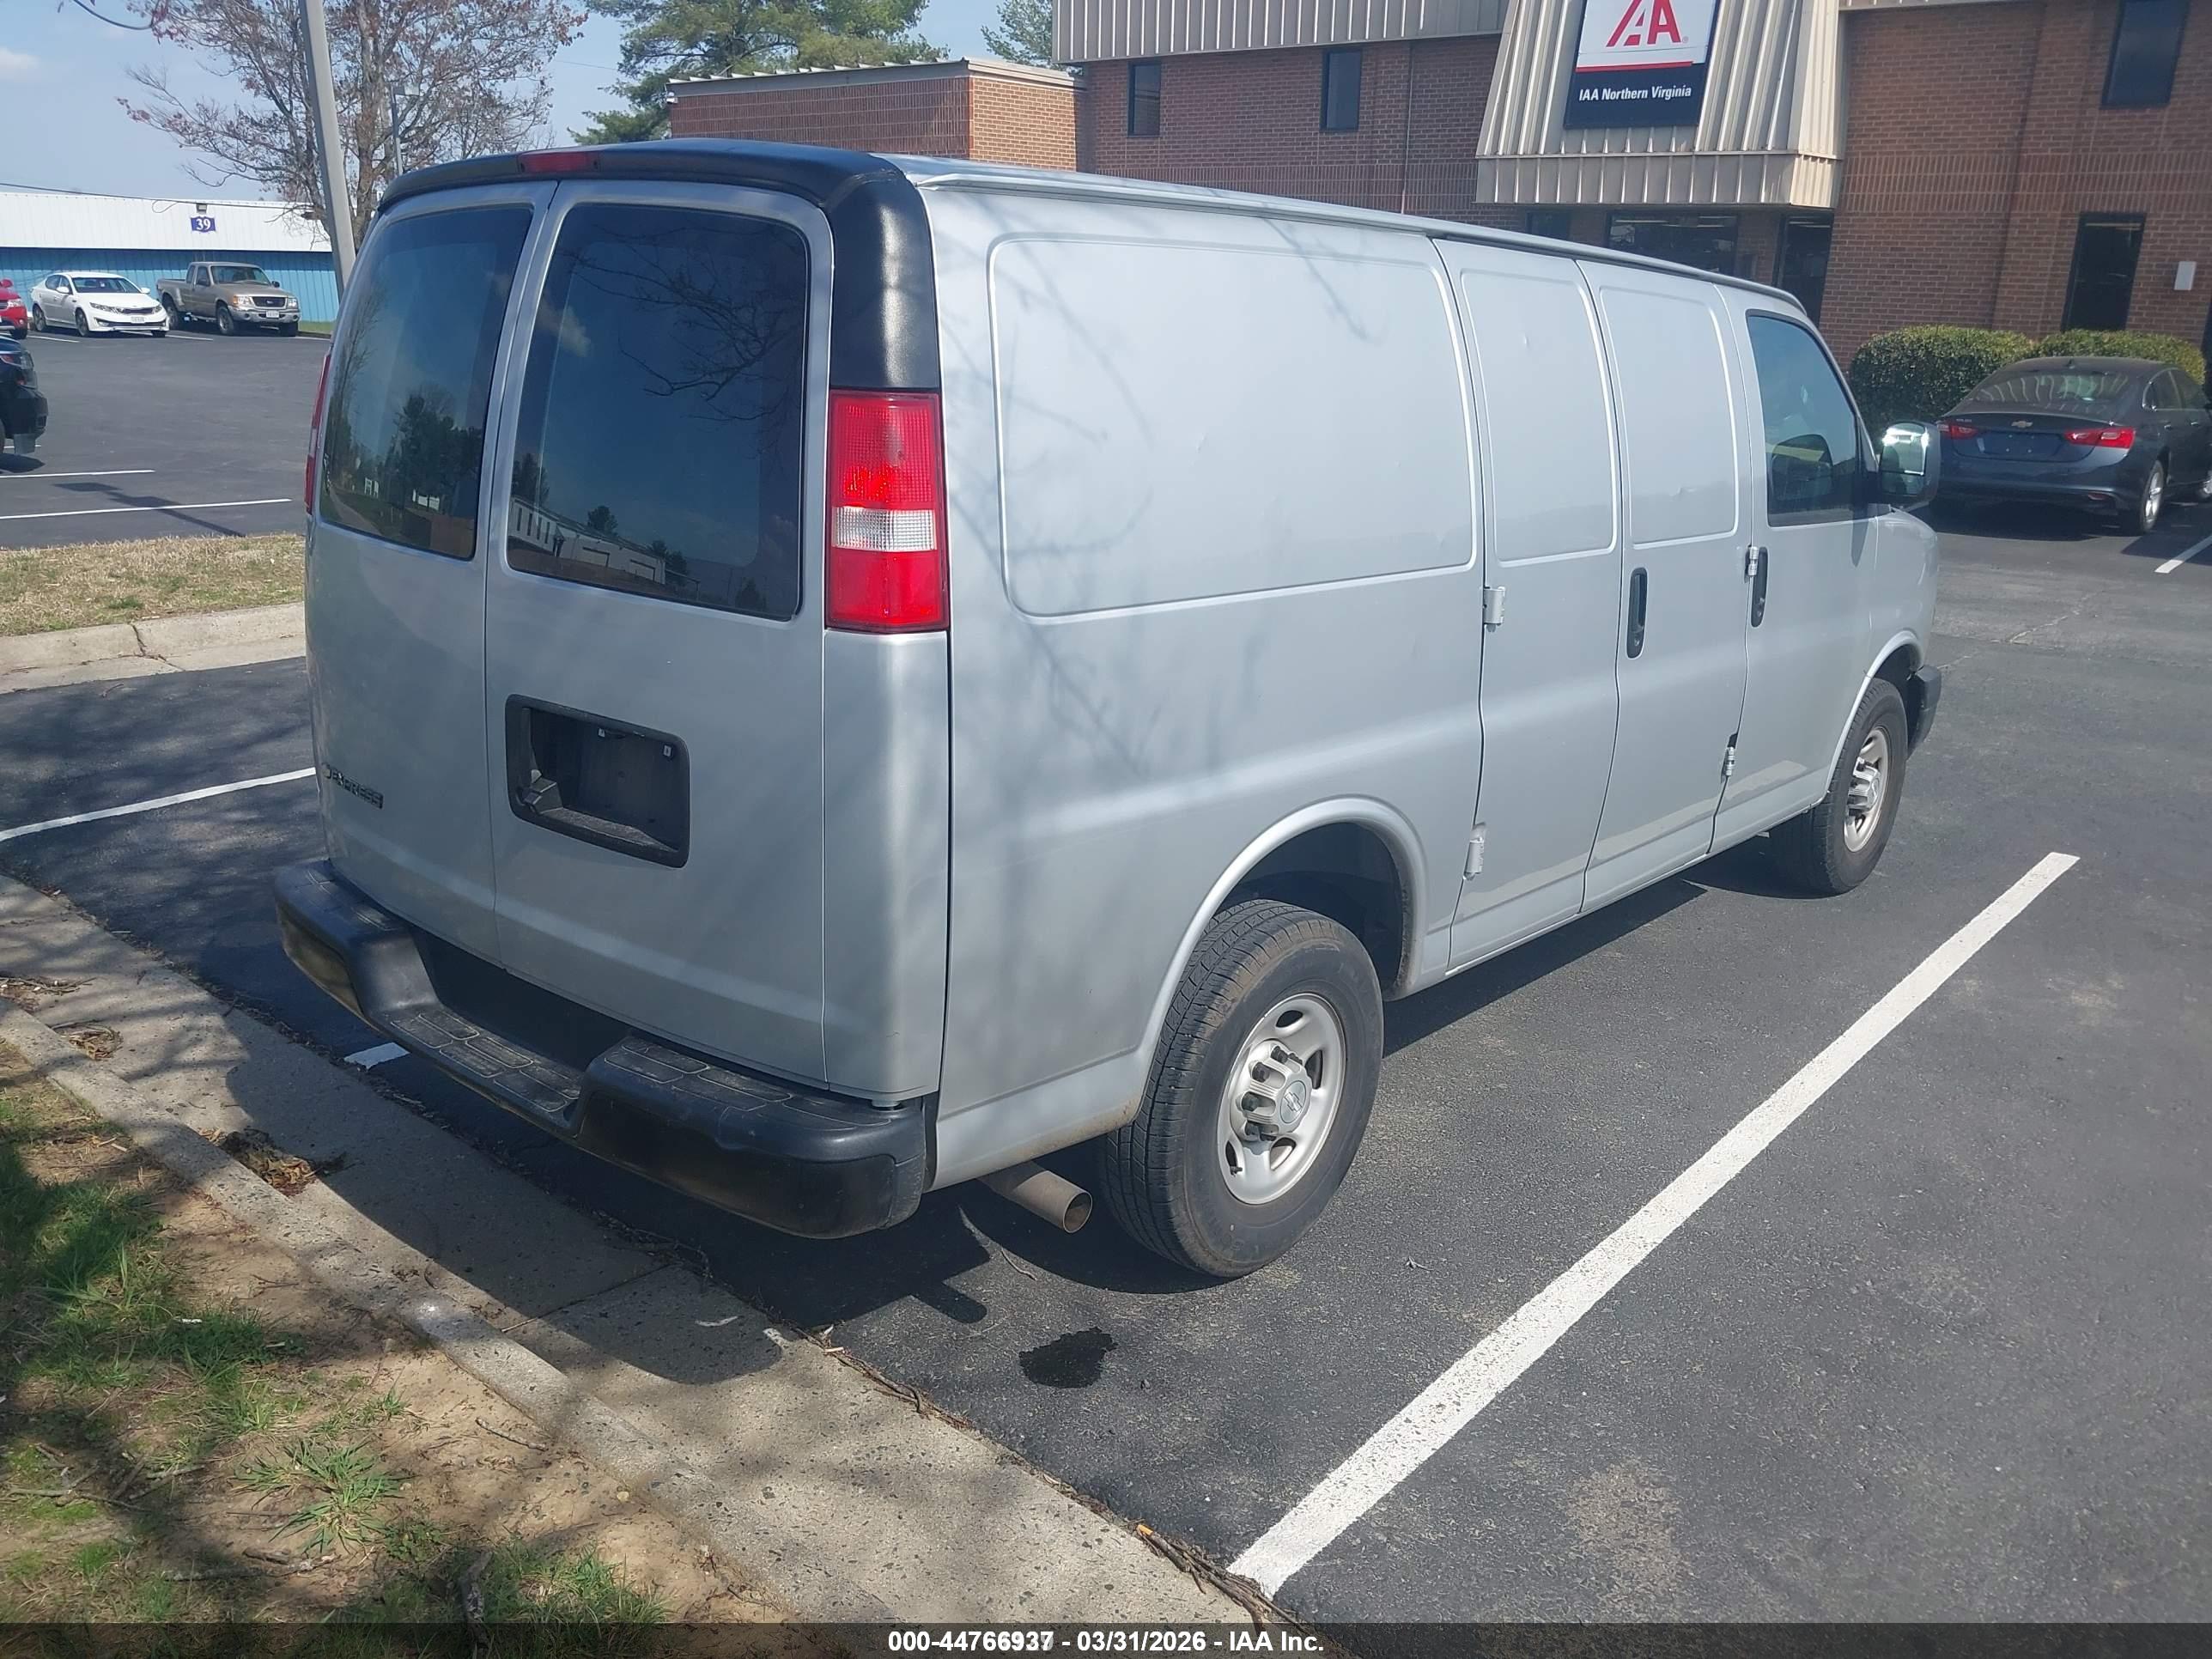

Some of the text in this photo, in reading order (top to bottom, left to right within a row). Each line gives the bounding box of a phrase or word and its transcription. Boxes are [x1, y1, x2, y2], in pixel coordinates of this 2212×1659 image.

[1579, 84, 1692, 101] IAA Northern Virginia
[196, 218, 211, 230] 39
